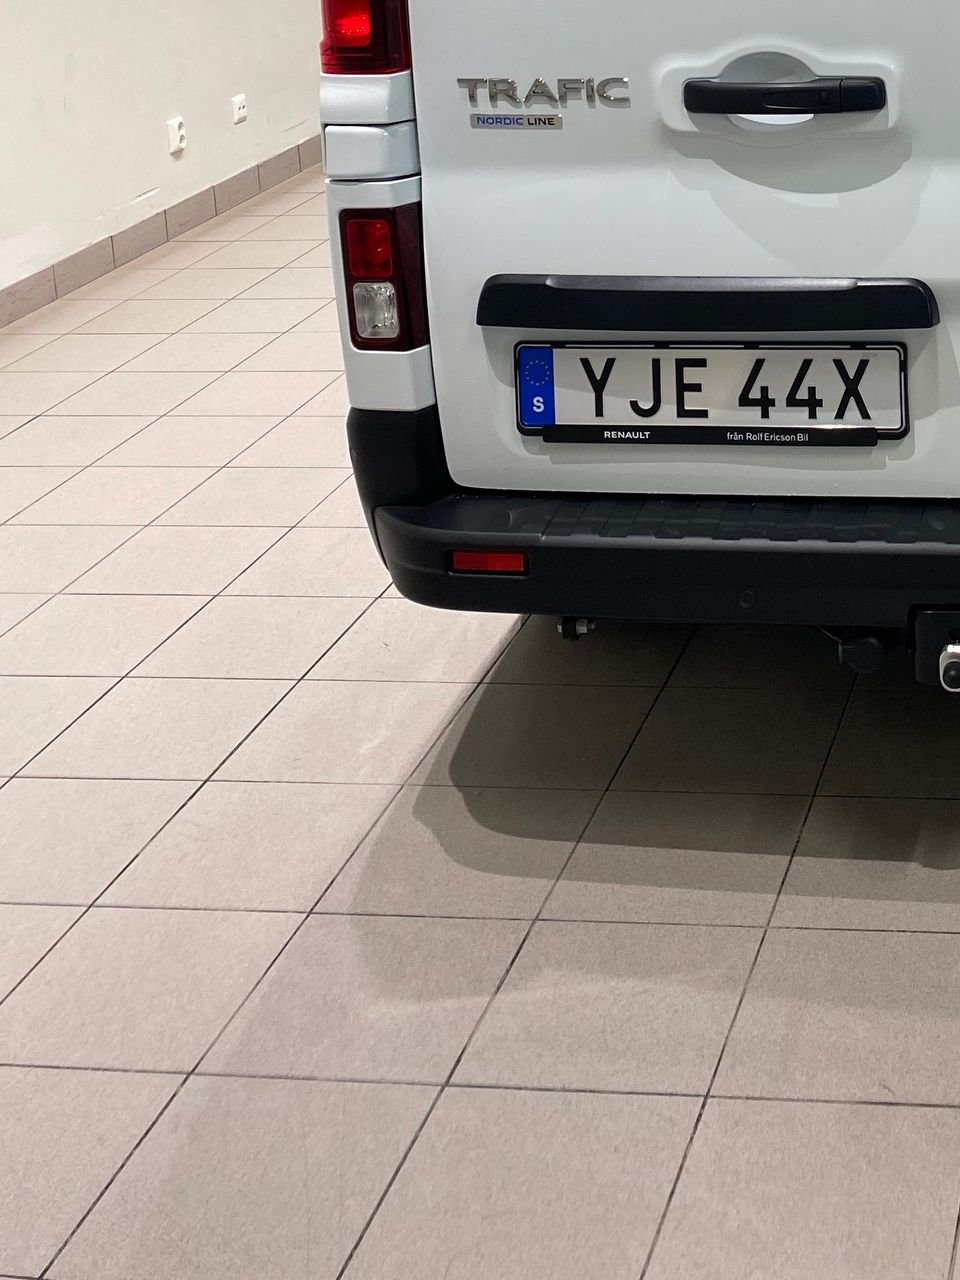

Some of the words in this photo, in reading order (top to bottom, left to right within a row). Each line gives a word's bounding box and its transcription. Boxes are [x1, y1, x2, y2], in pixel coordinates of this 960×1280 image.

[456, 77, 632, 109] TRAFIC
[476, 116, 524, 126] NORDIC
[527, 116, 555, 126] LINE
[579, 357, 709, 419] YJE
[738, 358, 872, 420] 44X
[532, 396, 545, 413] S
[603, 431, 651, 440] RENAULT
[726, 431, 744, 441] från
[745, 432, 763, 441] Rolf
[764, 432, 796, 442] Ericson
[797, 433, 809, 442] Bil
